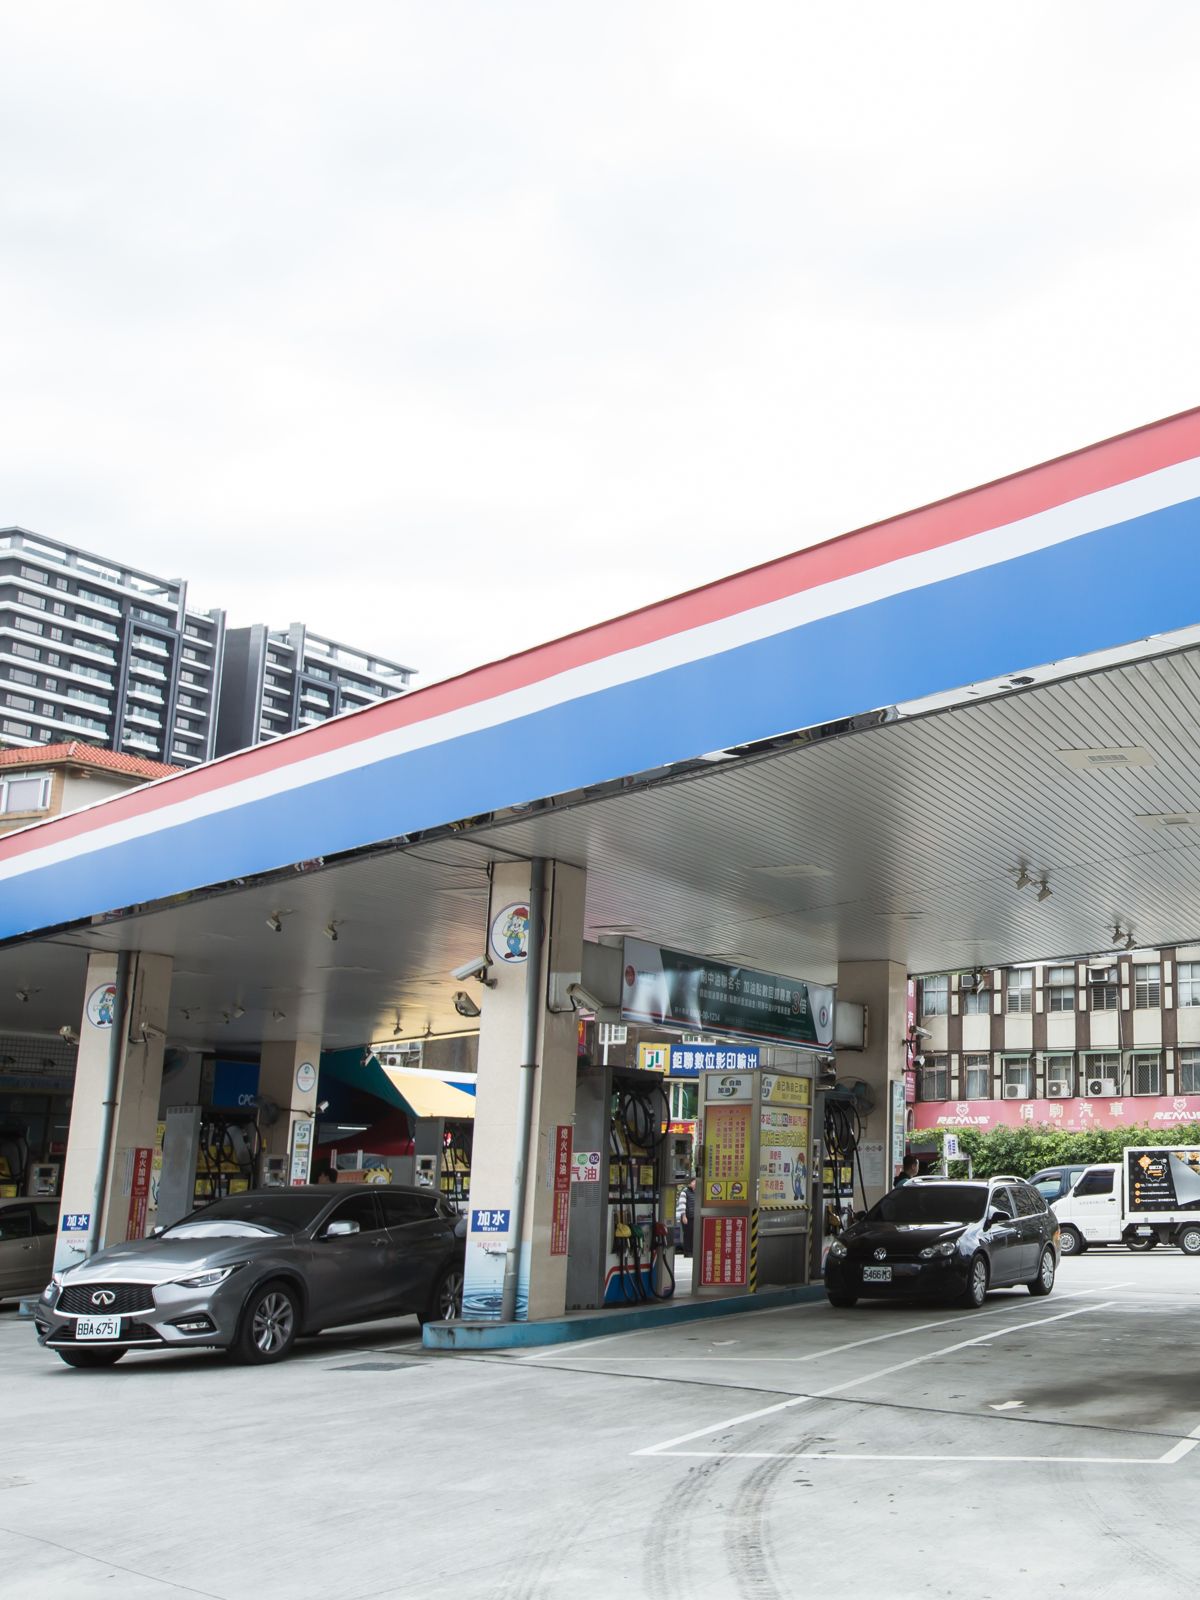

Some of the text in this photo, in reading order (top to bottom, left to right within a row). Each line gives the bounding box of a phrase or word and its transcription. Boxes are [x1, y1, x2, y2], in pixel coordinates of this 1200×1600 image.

[672, 1050, 758, 1070] 鉅聯數位影印輸出
[936, 1115, 989, 1125] REMUS
[590, 1154, 599, 1163] 92
[67, 1215, 88, 1227] 加水
[477, 1210, 505, 1226] 加水
[77, 1322, 118, 1336] BBA-6751
